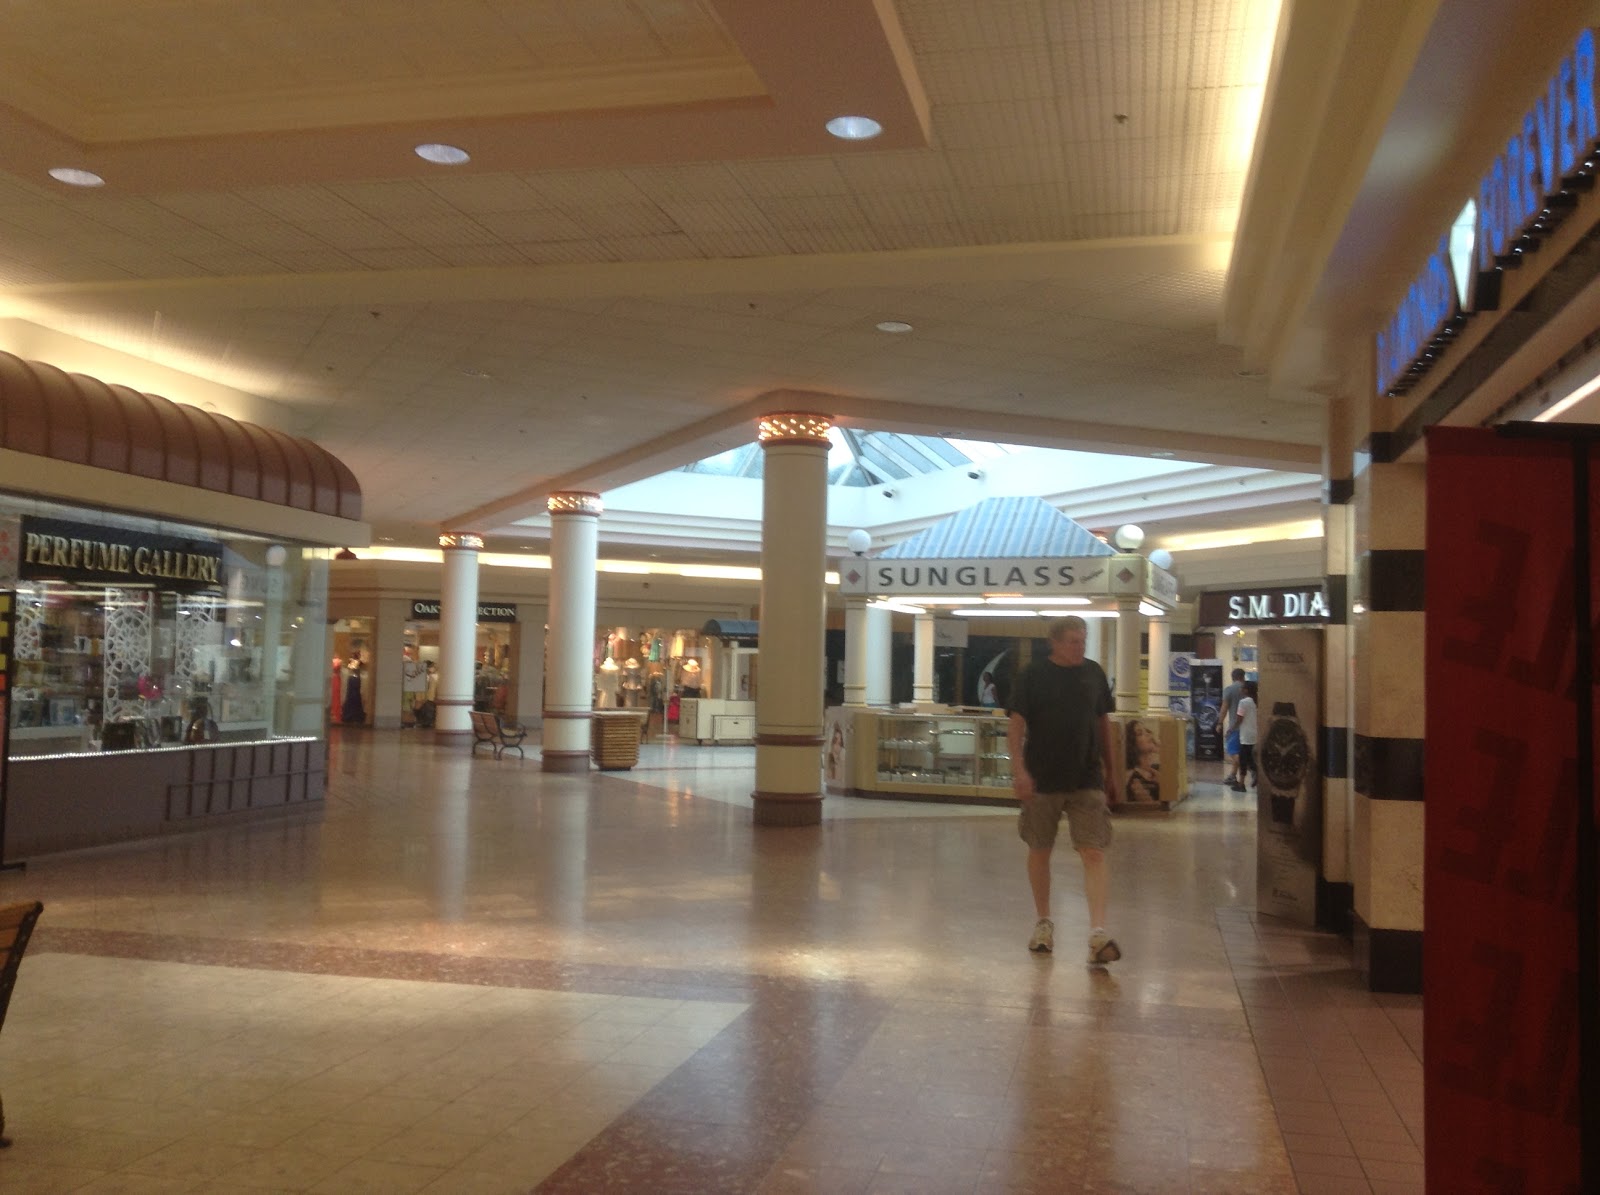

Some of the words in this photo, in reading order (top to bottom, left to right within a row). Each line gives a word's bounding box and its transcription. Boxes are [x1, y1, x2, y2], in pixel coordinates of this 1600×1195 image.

[25, 532, 132, 574] PERFUME
[134, 546, 220, 583] GALLERY
[878, 565, 1076, 587] SUNGLASS
[414, 602, 441, 614] OAK
[478, 606, 516, 617] ECTION
[1228, 595, 1277, 620] S.M.
